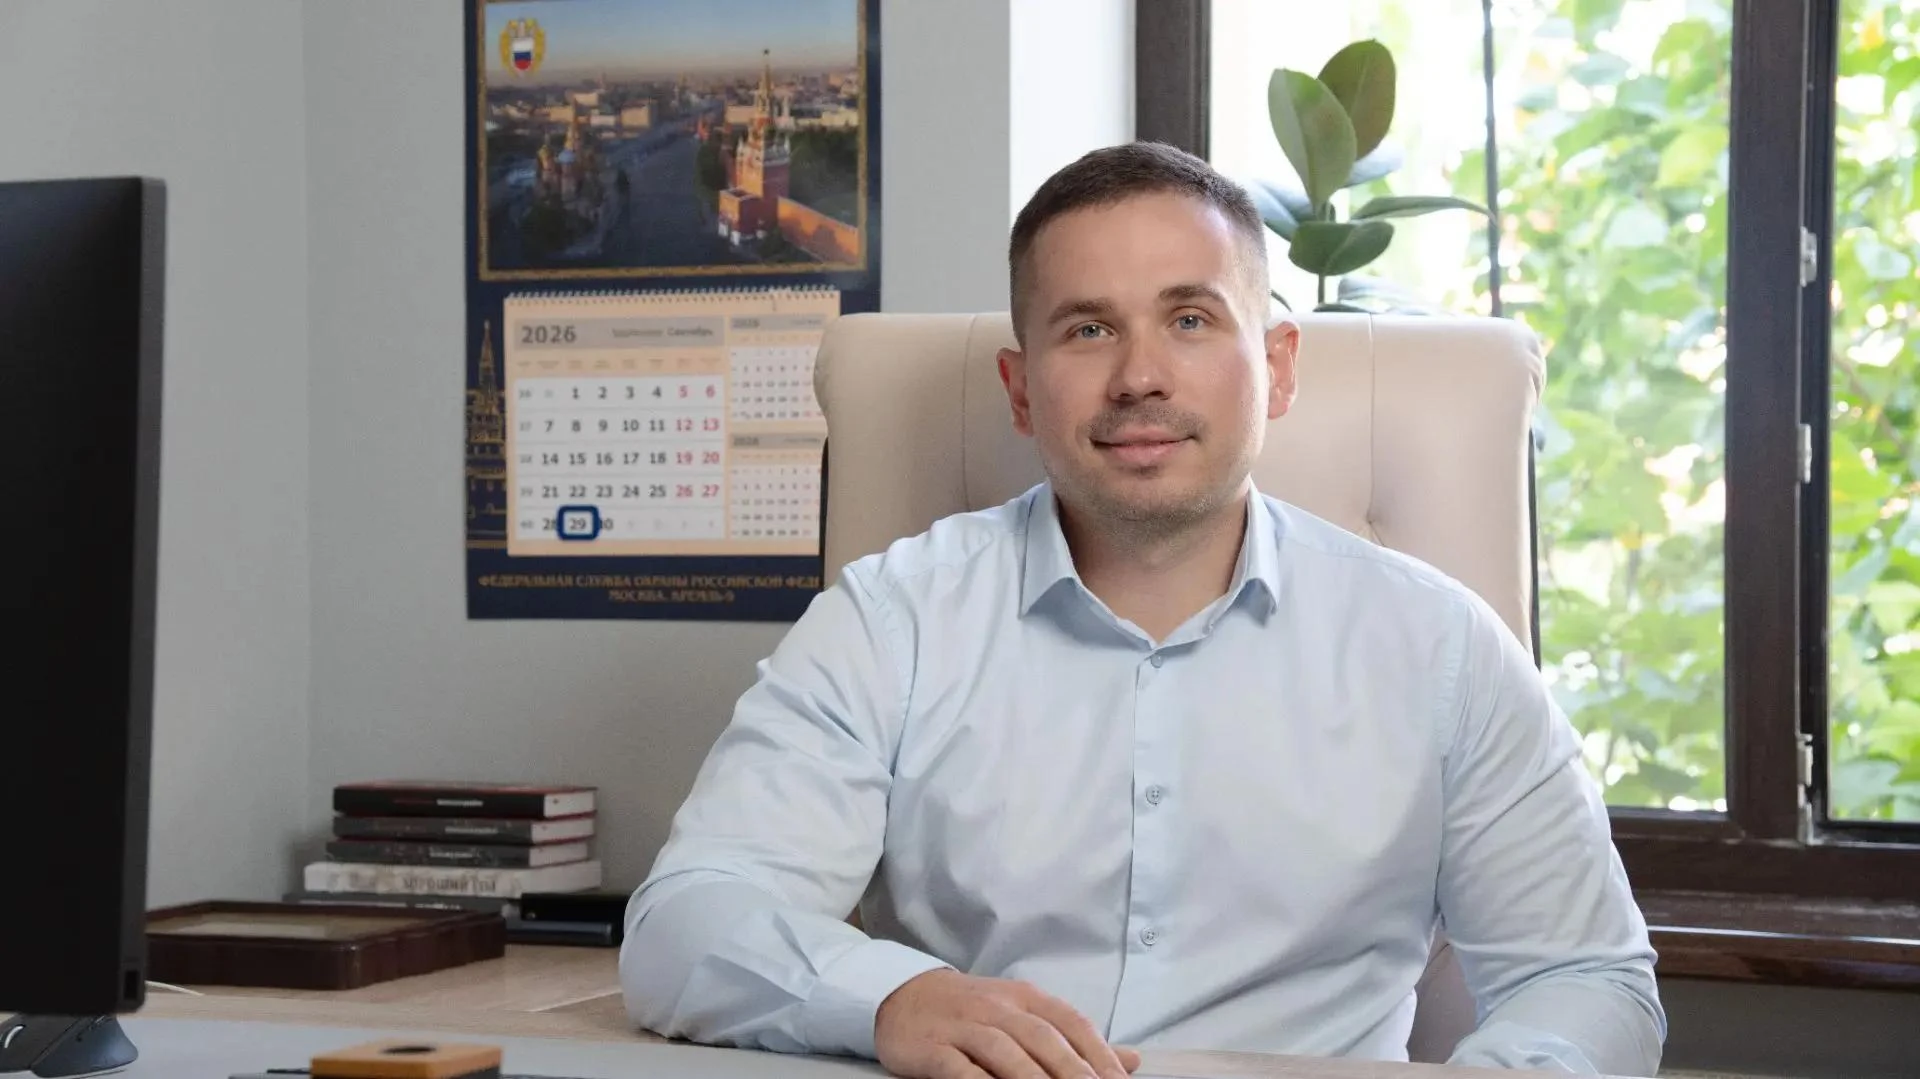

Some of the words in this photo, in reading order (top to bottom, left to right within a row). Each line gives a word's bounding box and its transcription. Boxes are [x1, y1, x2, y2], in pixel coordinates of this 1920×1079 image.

[520, 325, 577, 344] 2026
[572, 387, 580, 400] 1
[598, 387, 608, 400] 2
[625, 387, 635, 400] 3
[651, 386, 662, 399] 4
[679, 386, 688, 399] 5
[705, 386, 716, 399] 6
[544, 419, 555, 433] 7
[571, 419, 581, 433] 8
[598, 419, 608, 433] 9
[624, 419, 639, 433] 10
[650, 418, 664, 432] 11
[677, 418, 692, 432] 12
[703, 418, 719, 432] 13
[542, 452, 559, 465] 14
[569, 452, 586, 465] 15
[596, 452, 613, 465] 16
[624, 452, 639, 465] 17
[650, 451, 666, 464] 18
[677, 451, 693, 464] 19
[703, 451, 719, 464] 20
[542, 485, 559, 498] 21
[569, 485, 586, 498] 22
[596, 485, 613, 498] 23
[622, 485, 639, 498] 24
[649, 484, 666, 497] 25
[676, 484, 693, 497] 26
[702, 484, 719, 497] 27
[569, 518, 586, 531] 29
[478, 575, 574, 587] ФЕДЕРАЛЬНАЯ
[576, 575, 631, 587] СЛУЖБА
[634, 576, 688, 587] ОХРАНЫ
[691, 575, 783, 588] РОССИЙСКОЙ
